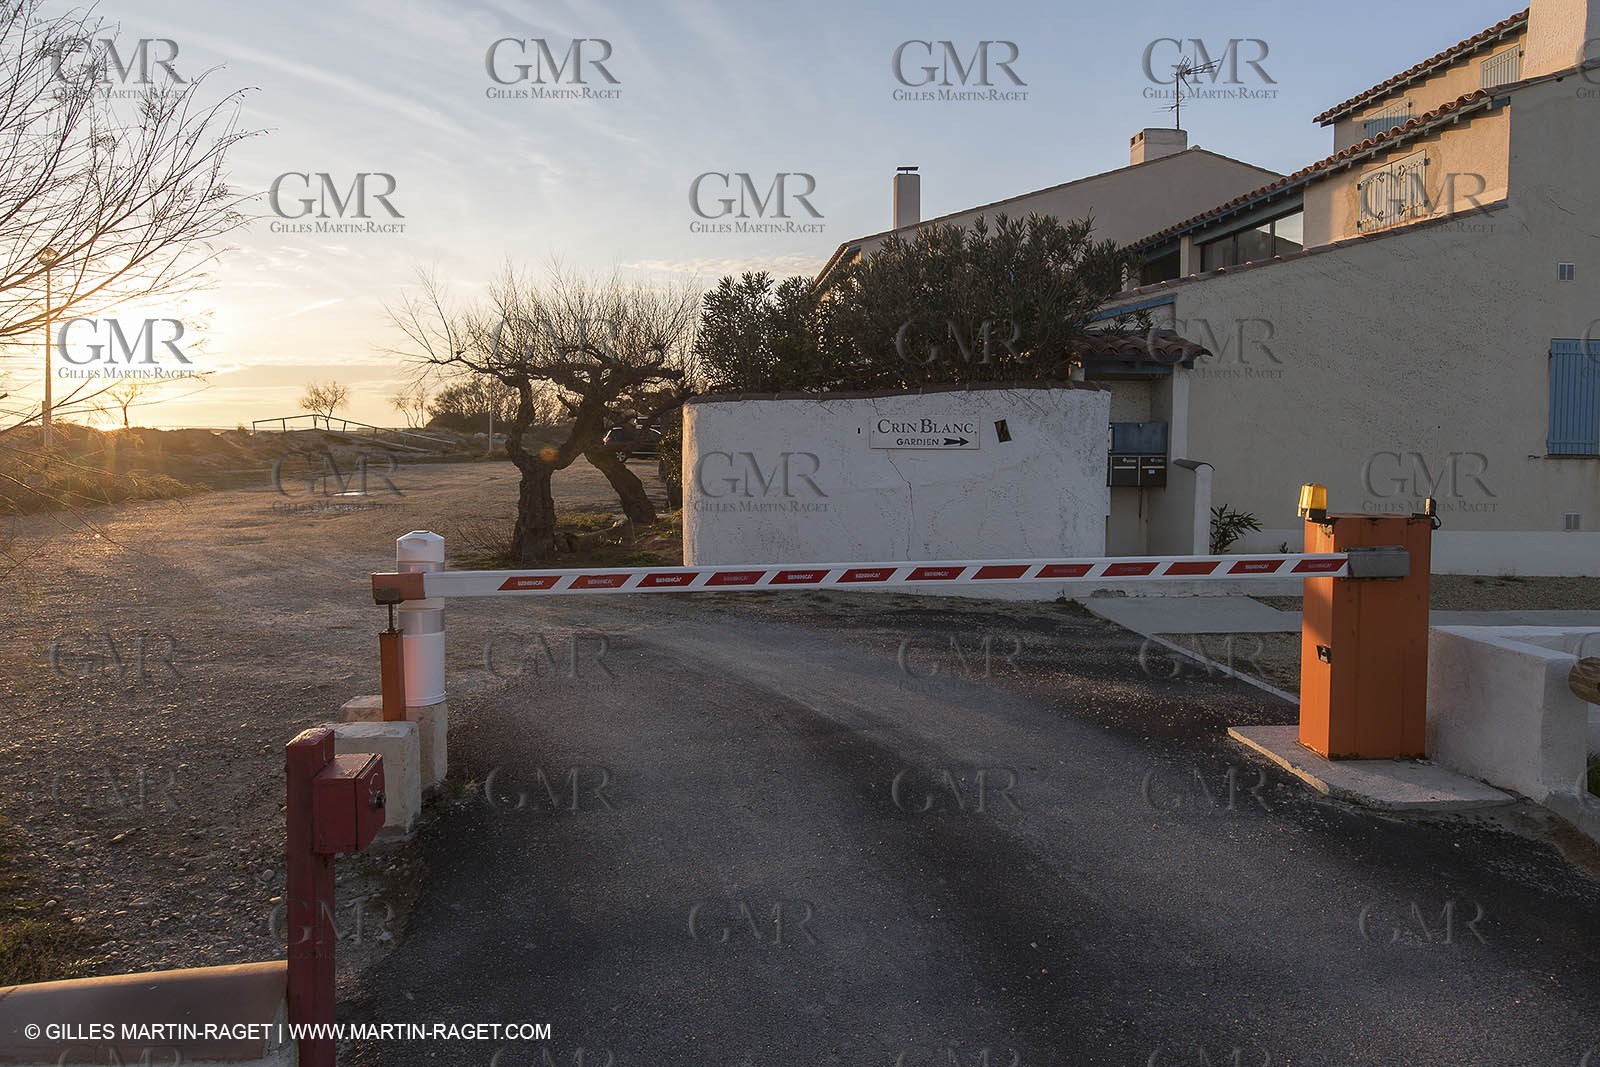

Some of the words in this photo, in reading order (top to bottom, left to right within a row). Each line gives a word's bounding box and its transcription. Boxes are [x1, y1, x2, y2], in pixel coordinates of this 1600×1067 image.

[877, 418, 917, 434] CRIN
[920, 418, 974, 434] BLANC
[896, 437, 940, 446] GARDIEN
